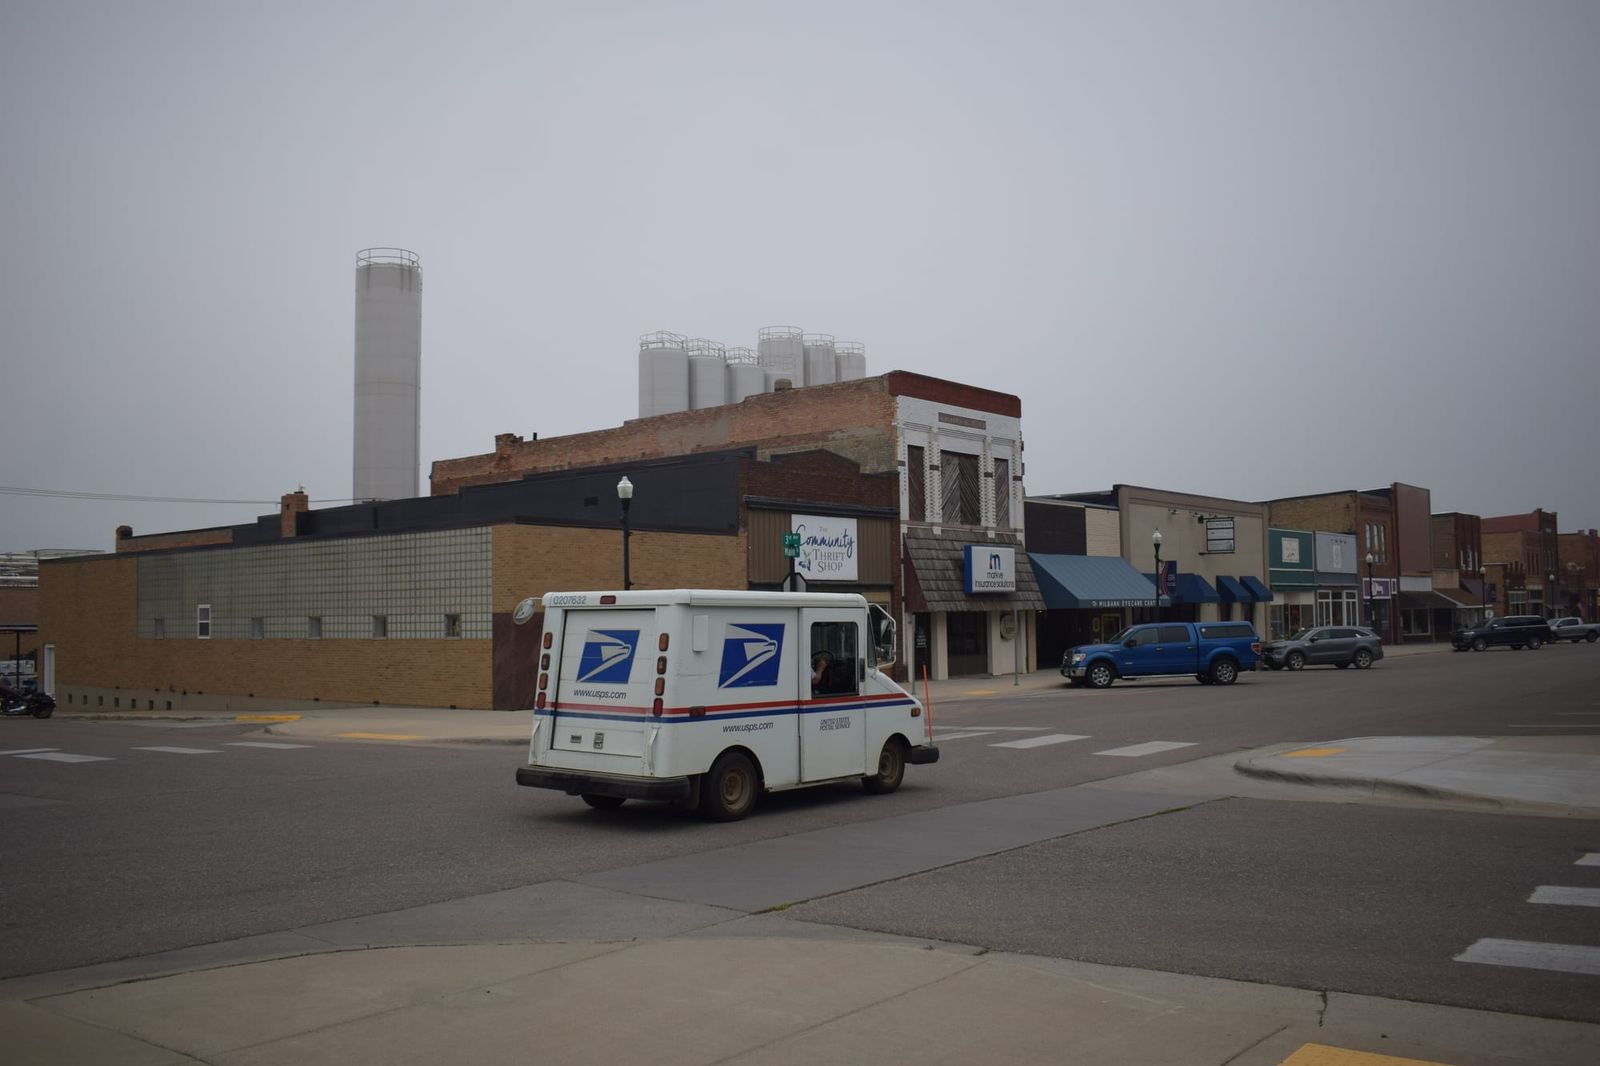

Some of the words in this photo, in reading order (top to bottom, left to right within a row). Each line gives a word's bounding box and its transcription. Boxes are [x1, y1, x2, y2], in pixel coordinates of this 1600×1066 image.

[796, 524, 855, 559] Community
[812, 549, 846, 562] THRIFT
[817, 561, 843, 573] SHOP
[553, 596, 587, 605] 0207632
[573, 689, 627, 700] www.usps.com
[722, 721, 774, 733] www.usps.com
